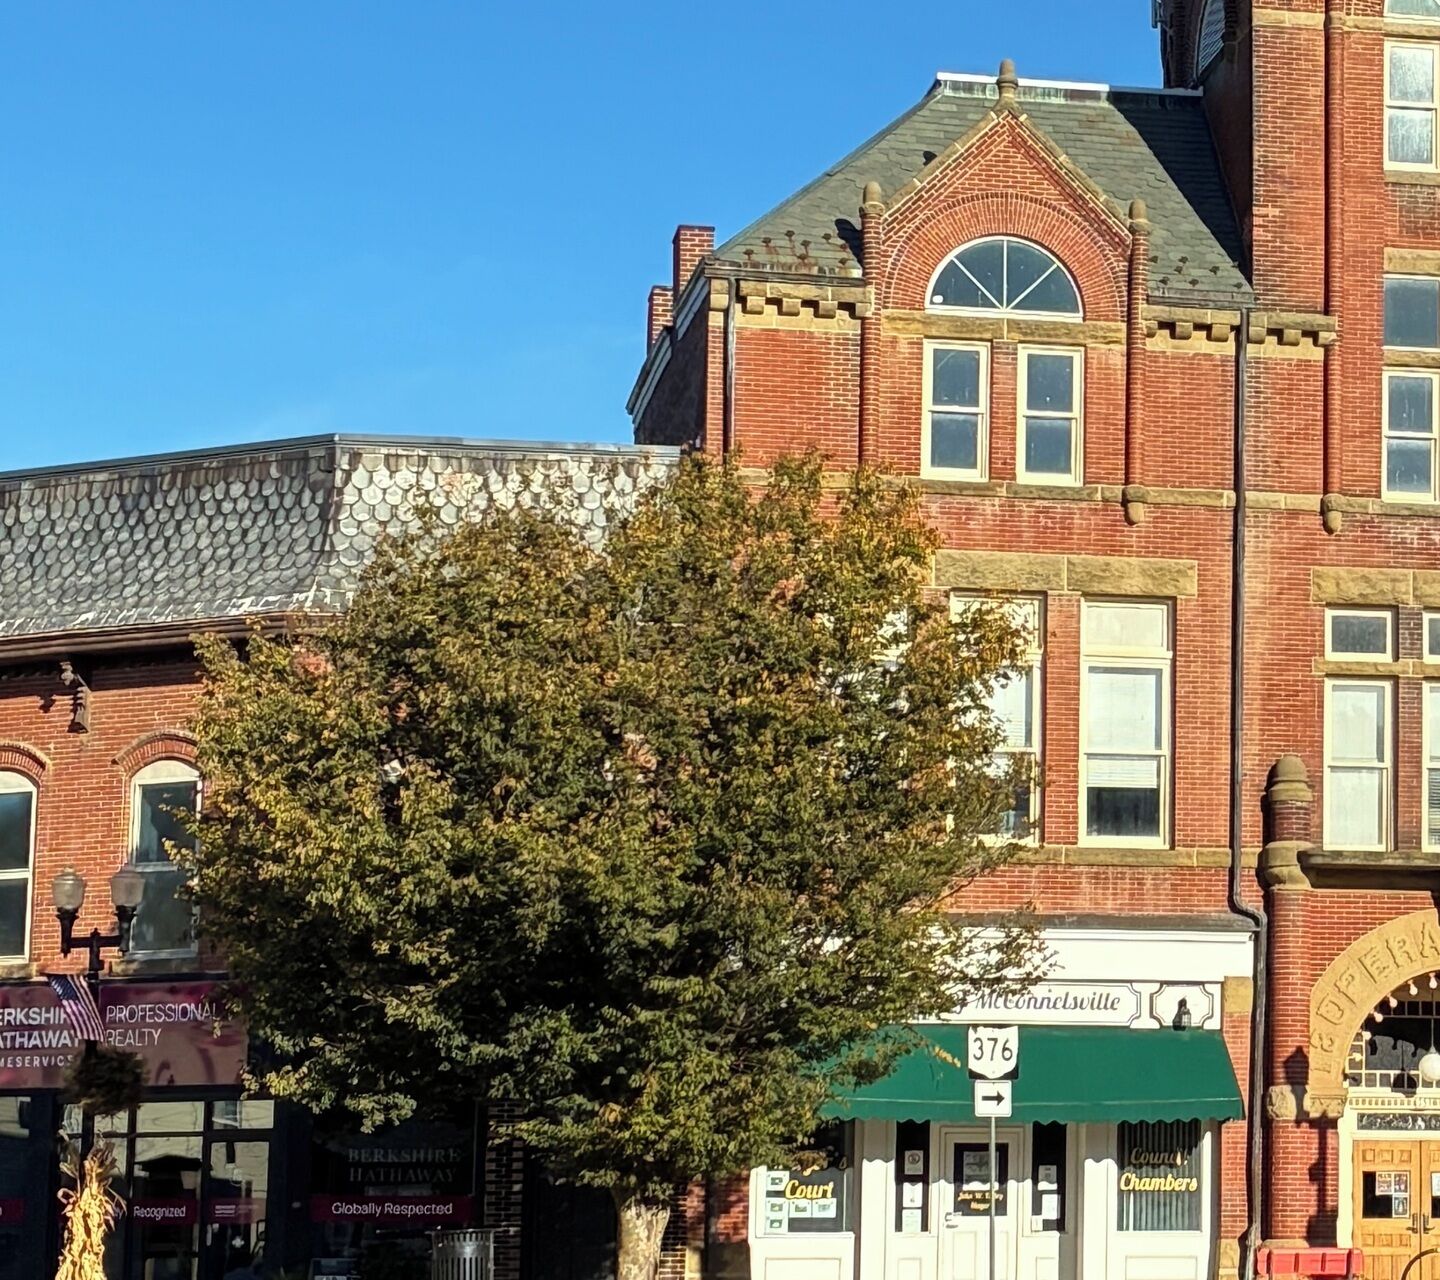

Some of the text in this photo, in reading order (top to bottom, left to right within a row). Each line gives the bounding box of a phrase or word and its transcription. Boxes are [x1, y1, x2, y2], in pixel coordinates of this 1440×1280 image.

[106, 1003, 217, 1023] PROFESSIONAL
[105, 1028, 162, 1048] REALTY
[973, 1037, 1013, 1062] 376
[348, 1148, 461, 1163] BERKSHIRE
[349, 1167, 457, 1183] HATHAWAY
[1120, 1172, 1198, 1191] Chambers
[785, 1179, 834, 1199] Court
[133, 1205, 186, 1221] Recognized
[332, 1201, 453, 1217] Globally Respected
